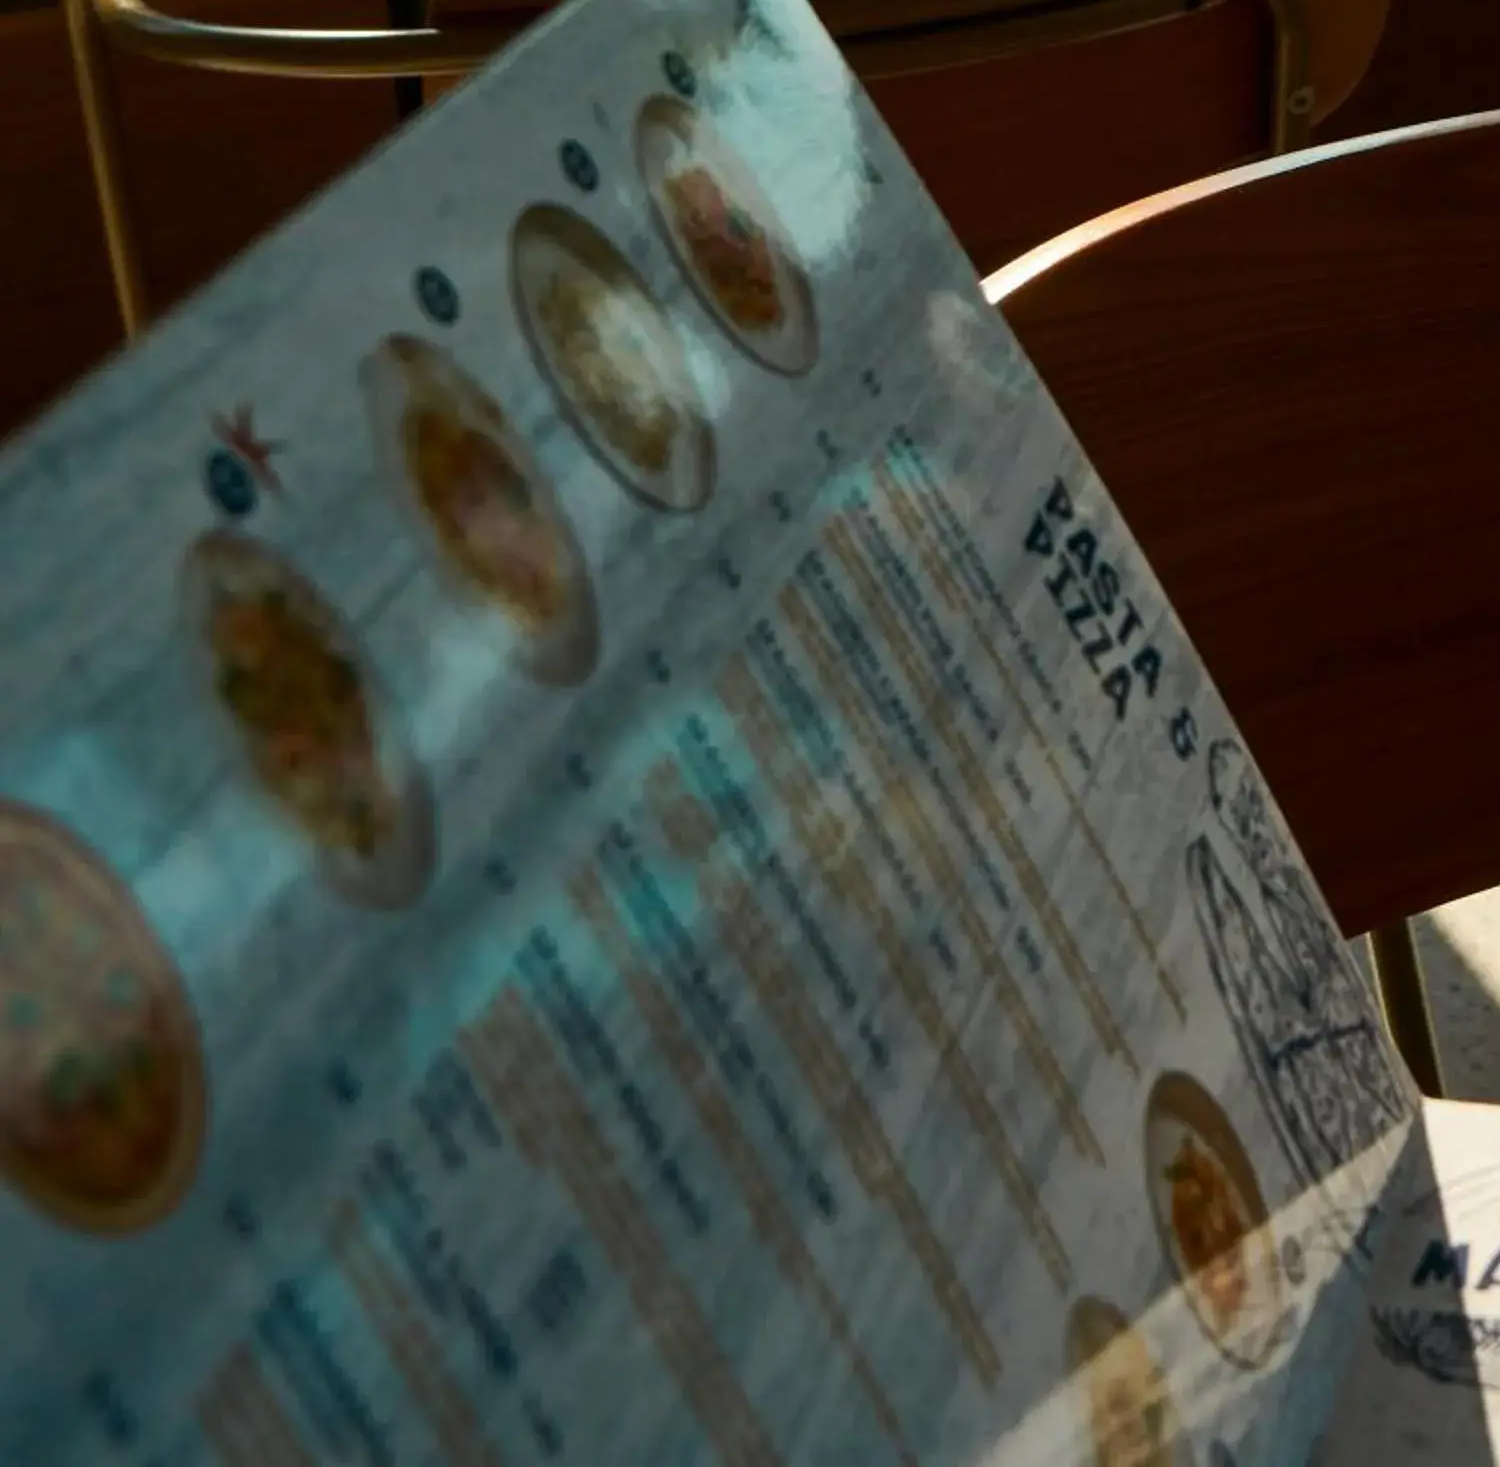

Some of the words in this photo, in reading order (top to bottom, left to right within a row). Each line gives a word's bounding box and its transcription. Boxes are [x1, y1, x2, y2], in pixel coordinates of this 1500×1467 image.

[1025, 513, 1133, 720] PIZZA
[1044, 479, 1162, 697] PASTA
[1170, 708, 1199, 761] &
